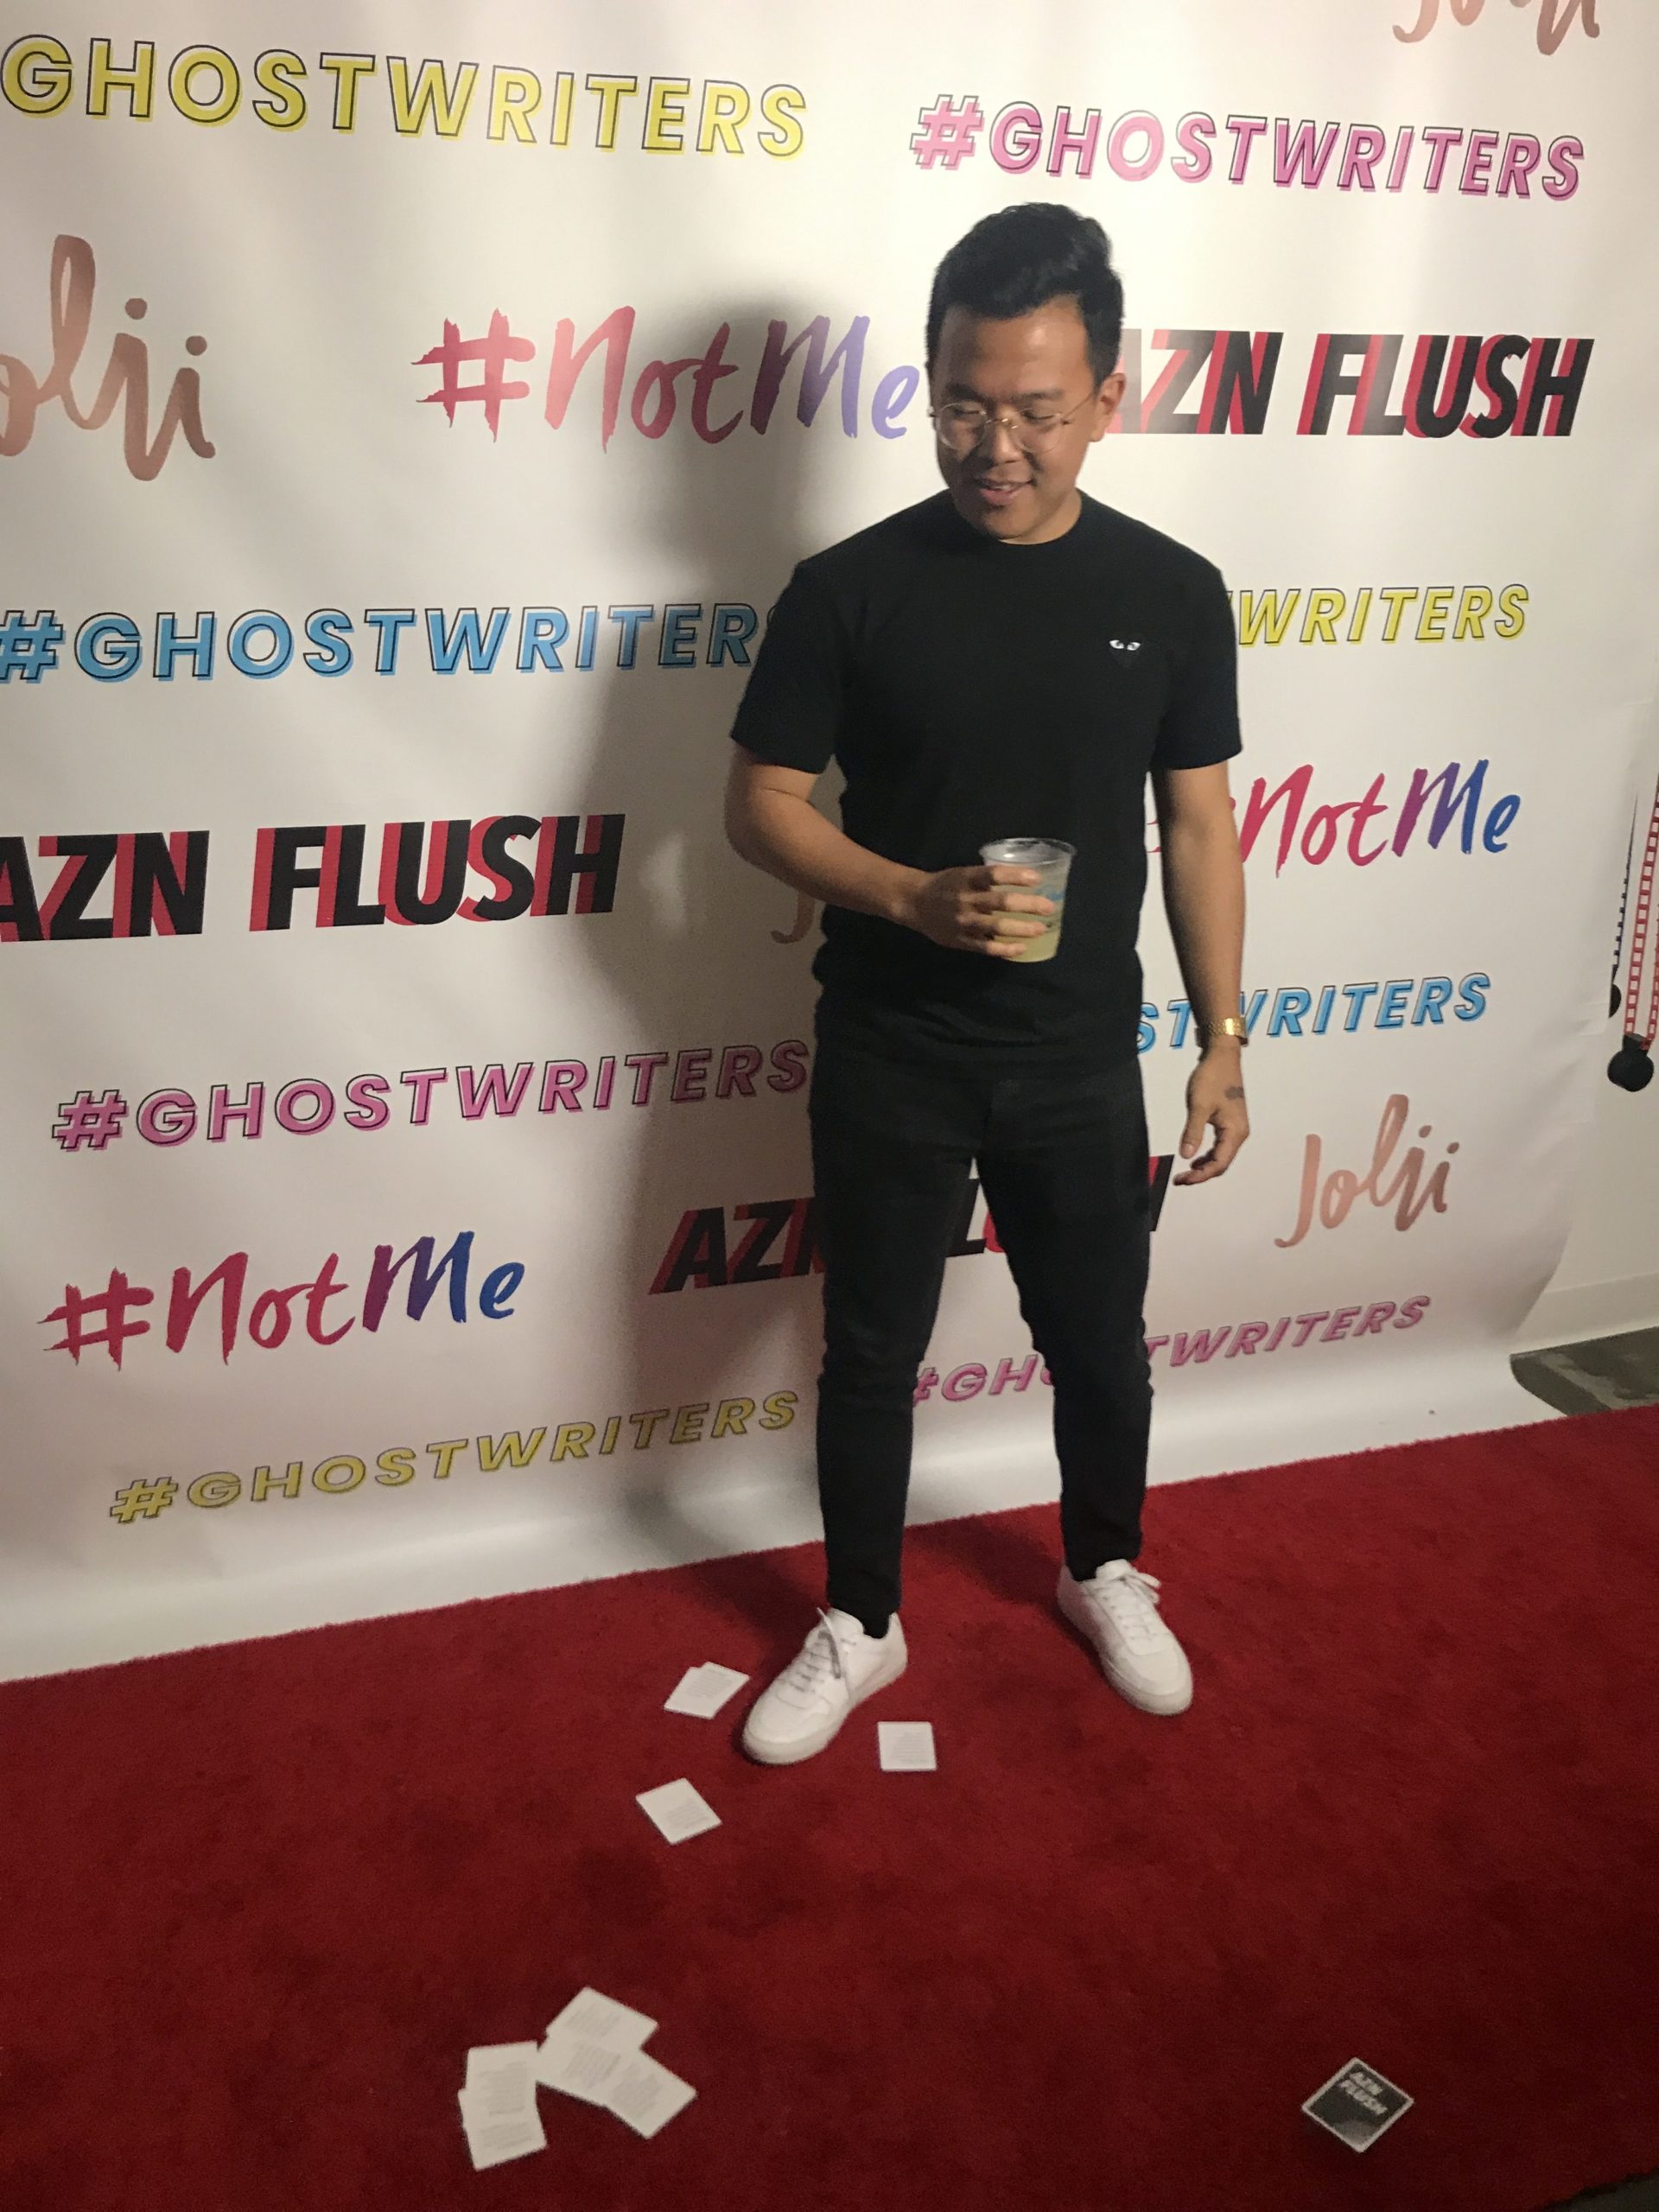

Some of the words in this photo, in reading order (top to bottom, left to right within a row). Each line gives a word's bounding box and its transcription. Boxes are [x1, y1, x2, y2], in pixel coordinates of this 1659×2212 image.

[0, 34, 808, 158] GHOSTWRITERS
[909, 94, 1586, 200] #GHOSTWRITERS
[410, 306, 919, 454] #NotMe
[1296, 334, 1595, 438] FLUSH
[0, 601, 780, 683] #GHOSTWRITER
[1227, 583, 1529, 646] WRITERS
[249, 814, 626, 931] FLUSH
[1147, 759, 1521, 879] NotMe
[52, 1039, 812, 1152] #GHOSTWRITERS
[36, 1230, 525, 1372] #NotMe
[109, 1390, 799, 1524] #GHOSTWRITERS
